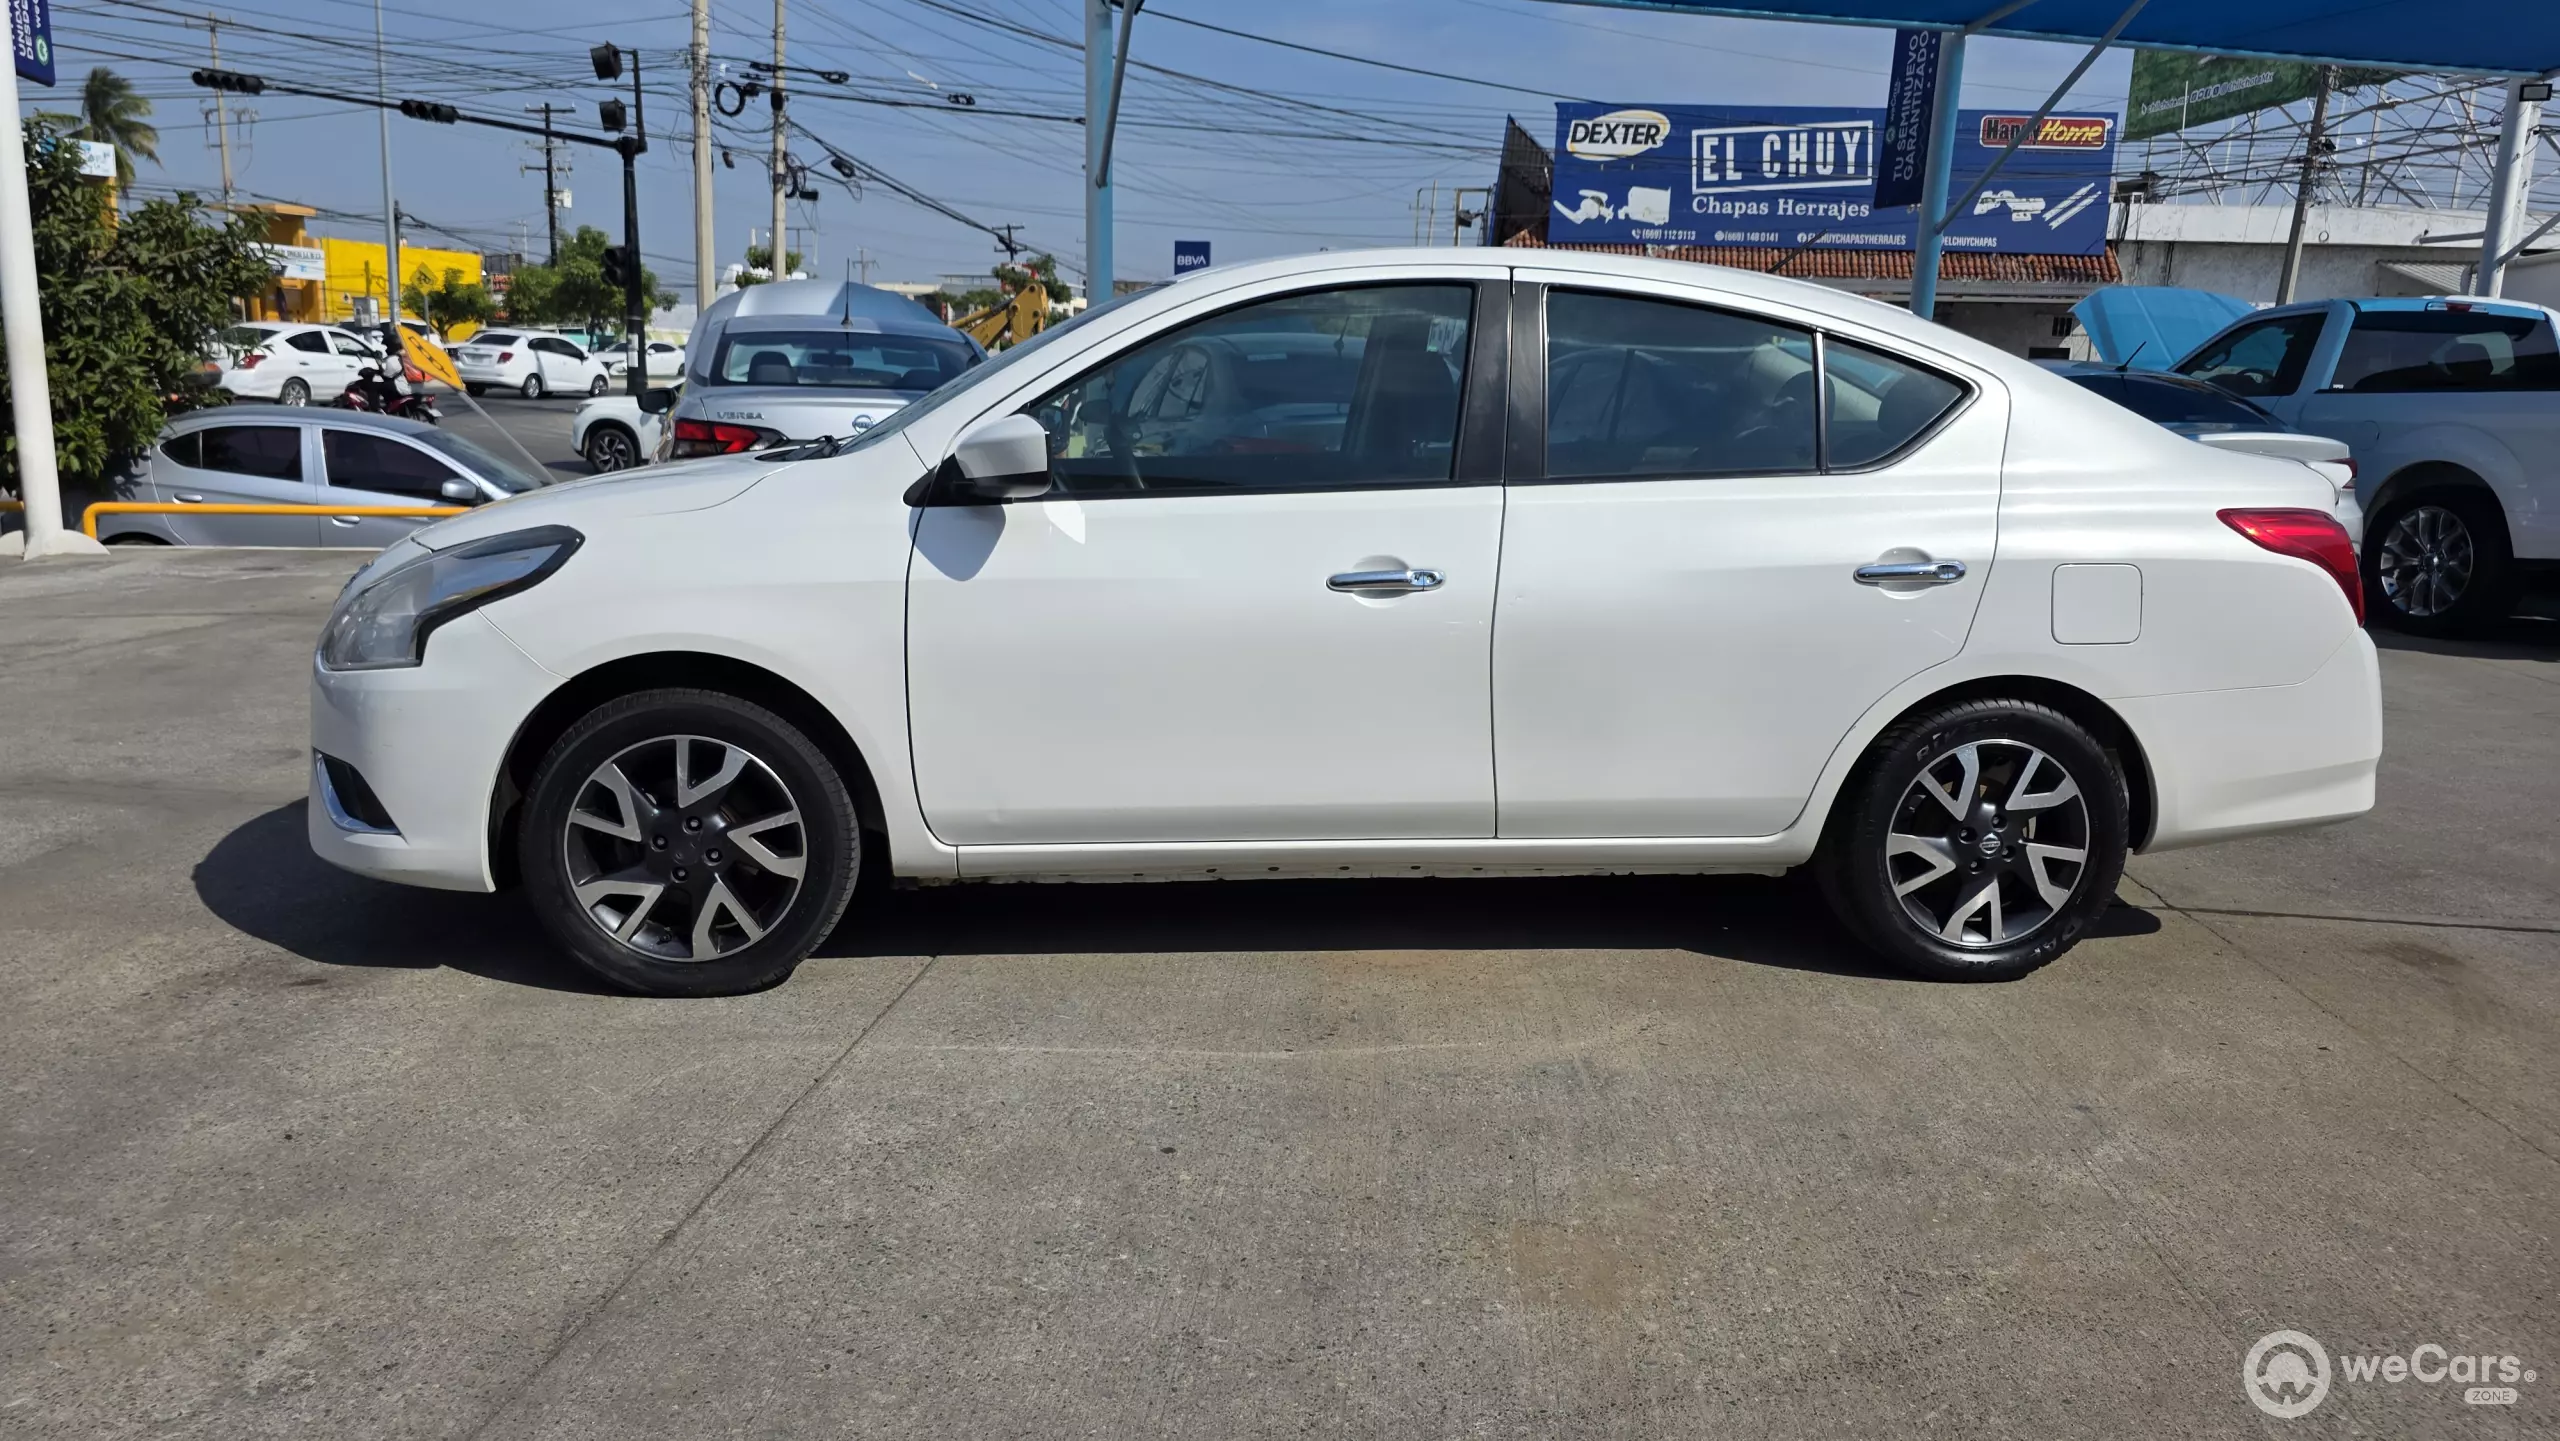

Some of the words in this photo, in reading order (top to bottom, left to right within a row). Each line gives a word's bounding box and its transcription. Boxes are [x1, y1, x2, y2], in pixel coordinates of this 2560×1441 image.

[1897, 35, 1918, 151] SEMINUEVO
[1903, 30, 1929, 180] GARANTIZADO
[1570, 122, 1660, 145] DEXTER
[1703, 136, 1742, 181] EL
[1762, 131, 1861, 178] CHUY
[1893, 156, 1904, 181] TU
[1692, 196, 1769, 219] Chapas
[1777, 198, 1870, 221] Herrajes
[1177, 255, 1206, 266] BBVA
[717, 411, 764, 420] VERSA
